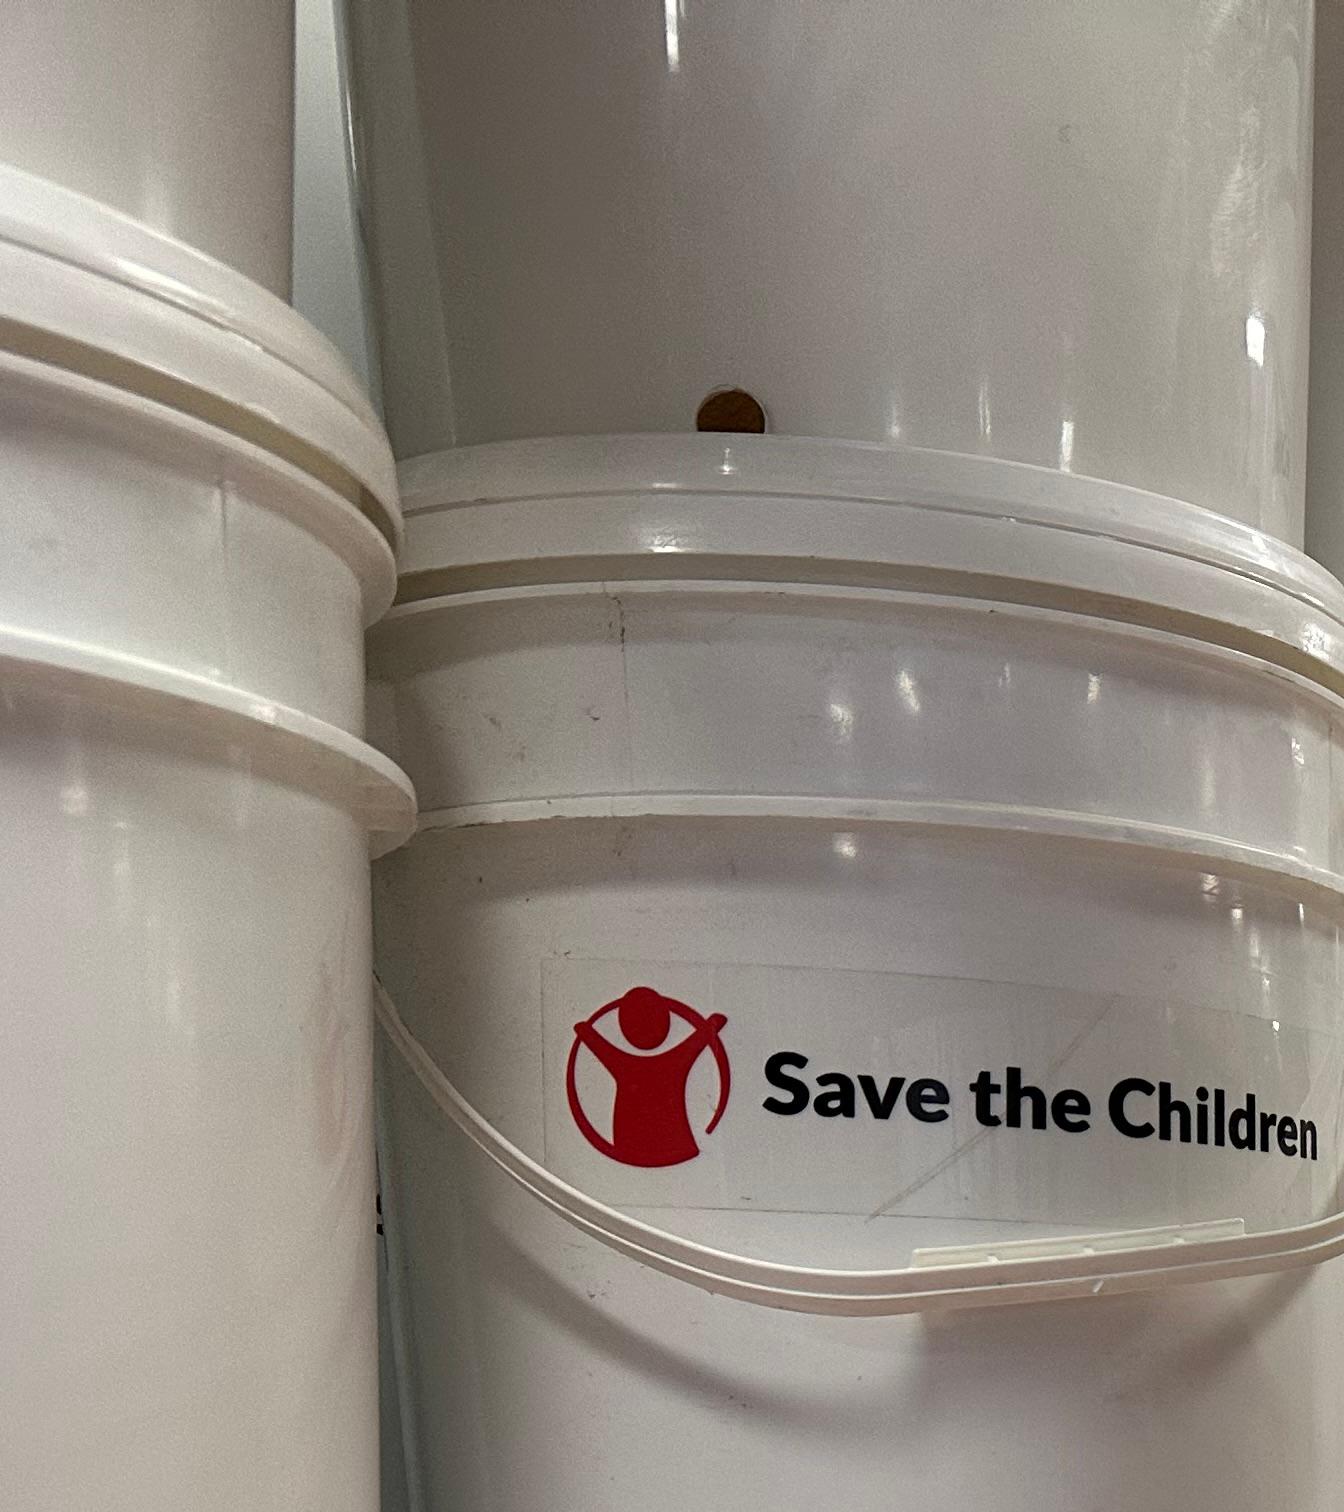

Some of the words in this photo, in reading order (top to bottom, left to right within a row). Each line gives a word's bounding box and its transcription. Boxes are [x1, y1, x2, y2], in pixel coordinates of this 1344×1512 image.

[762, 1051, 951, 1124] Save
[968, 1066, 1092, 1134] the
[1108, 1077, 1319, 1161] Children
